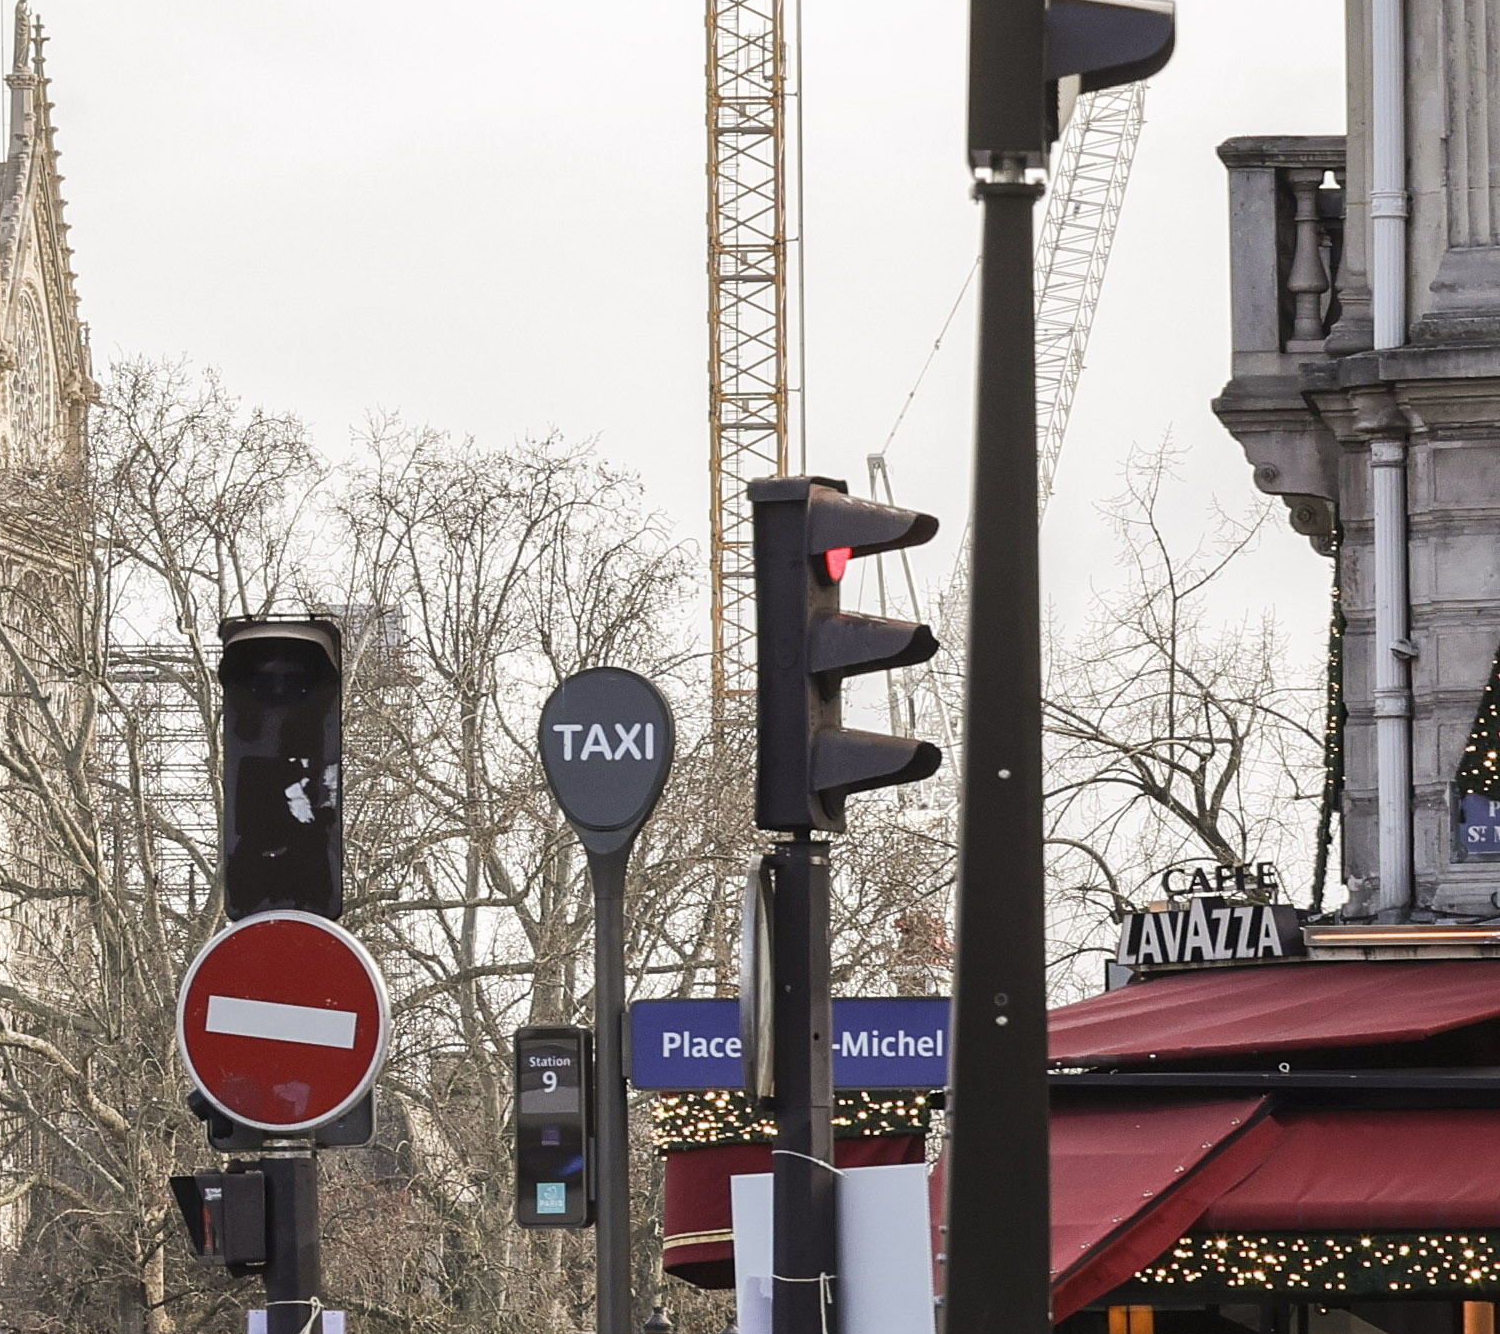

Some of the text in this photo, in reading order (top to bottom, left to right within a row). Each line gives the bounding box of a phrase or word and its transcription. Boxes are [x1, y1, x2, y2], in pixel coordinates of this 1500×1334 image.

[552, 723, 655, 761] TAXI
[1117, 897, 1283, 966] LAVAZZA
[662, 1029, 944, 1058] Place -Michel
[529, 1055, 571, 1068] Station
[542, 1070, 557, 1093] 9
